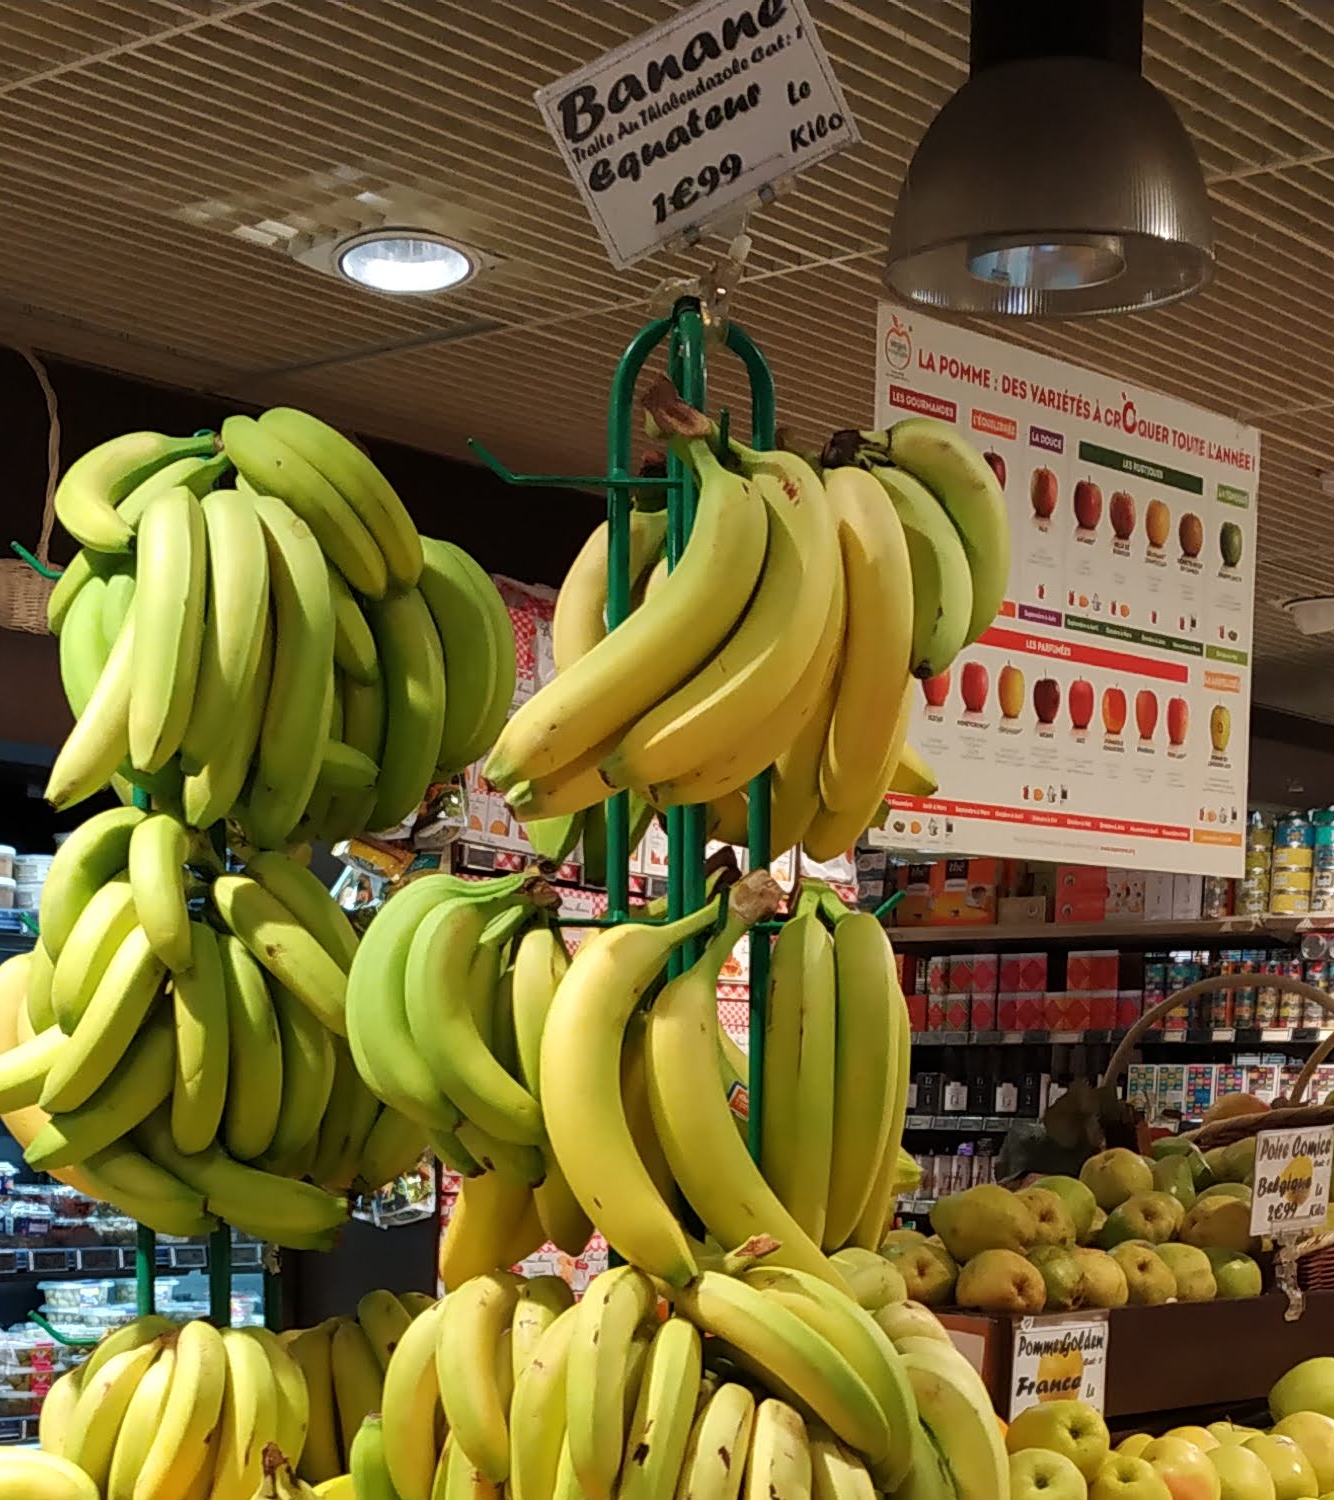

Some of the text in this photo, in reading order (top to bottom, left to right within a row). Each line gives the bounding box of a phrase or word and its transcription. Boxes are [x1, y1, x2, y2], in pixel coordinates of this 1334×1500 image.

[557, 0, 789, 144] Banane
[787, 80, 811, 106] Le
[790, 113, 843, 153] Kilo
[918, 348, 936, 373] LA
[940, 354, 991, 388] POMME
[1002, 375, 1027, 400] DES
[1030, 383, 1091, 420] VARIÉTÉS
[1172, 430, 1206, 457] TOUTE
[1016, 1375, 1083, 1397] France
